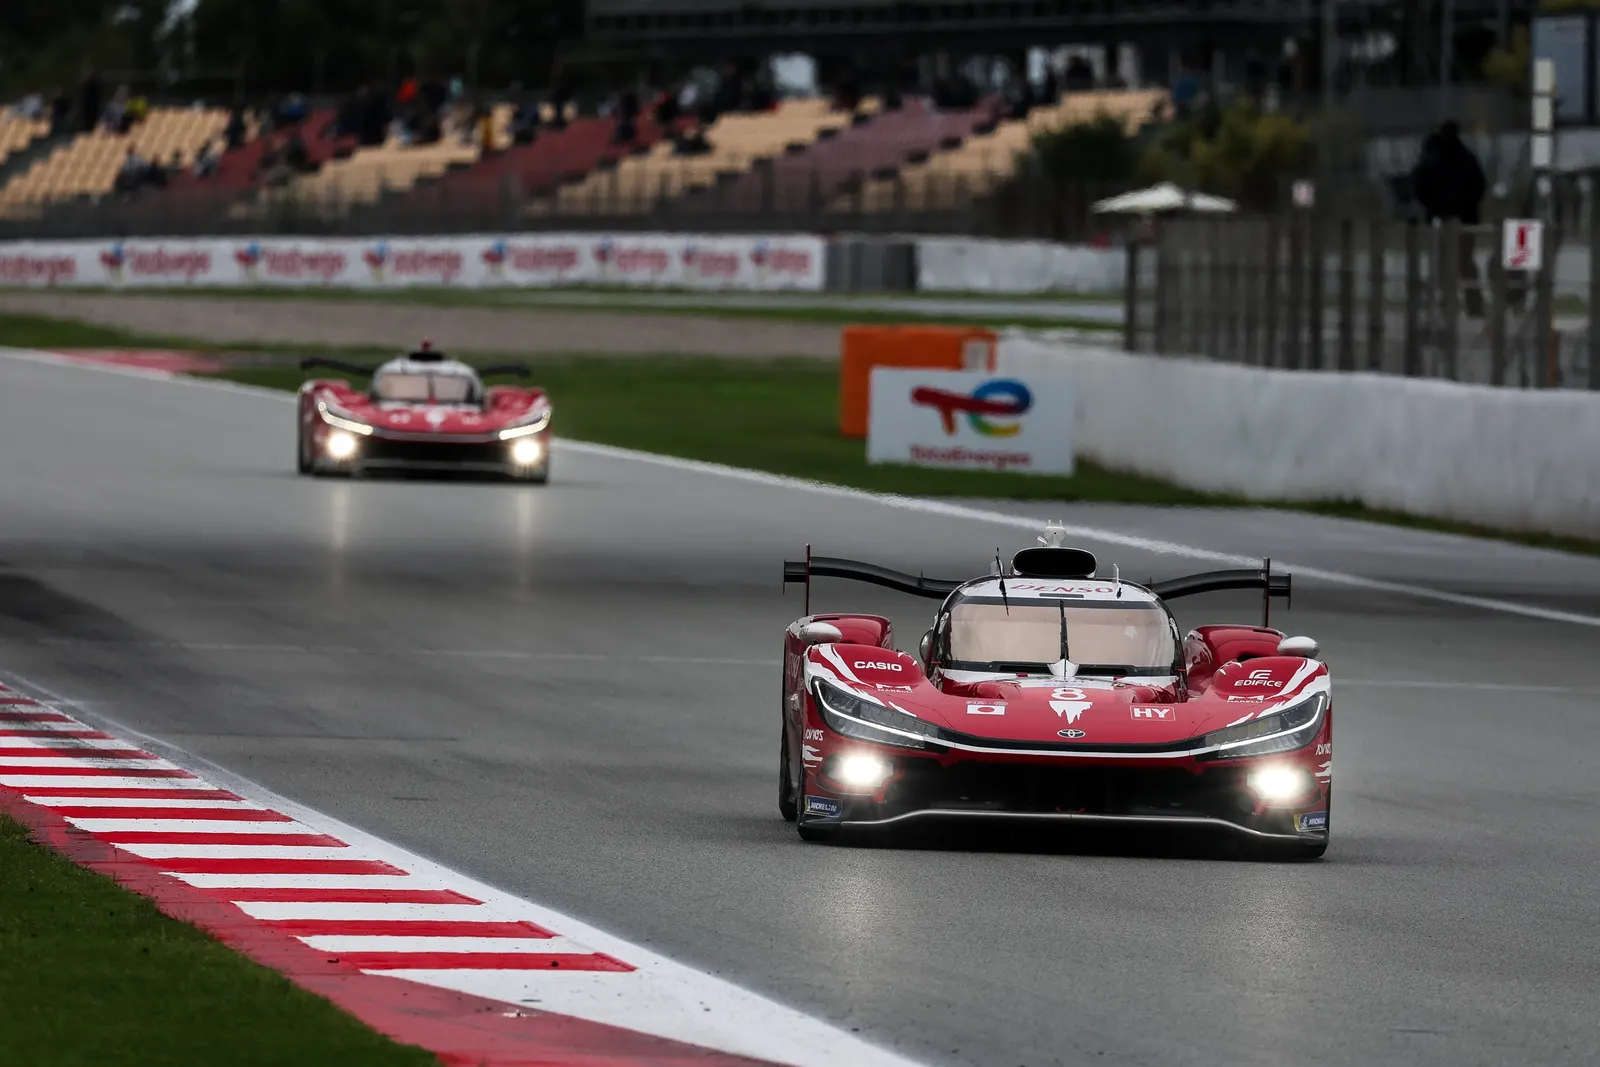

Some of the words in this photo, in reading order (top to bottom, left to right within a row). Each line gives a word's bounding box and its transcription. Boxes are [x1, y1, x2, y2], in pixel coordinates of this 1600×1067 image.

[1010, 584, 1114, 594] DENSO
[854, 661, 902, 672] CASIO
[1234, 679, 1283, 688] EDIFICE
[1051, 687, 1087, 700] 8
[1134, 707, 1171, 718] HY
